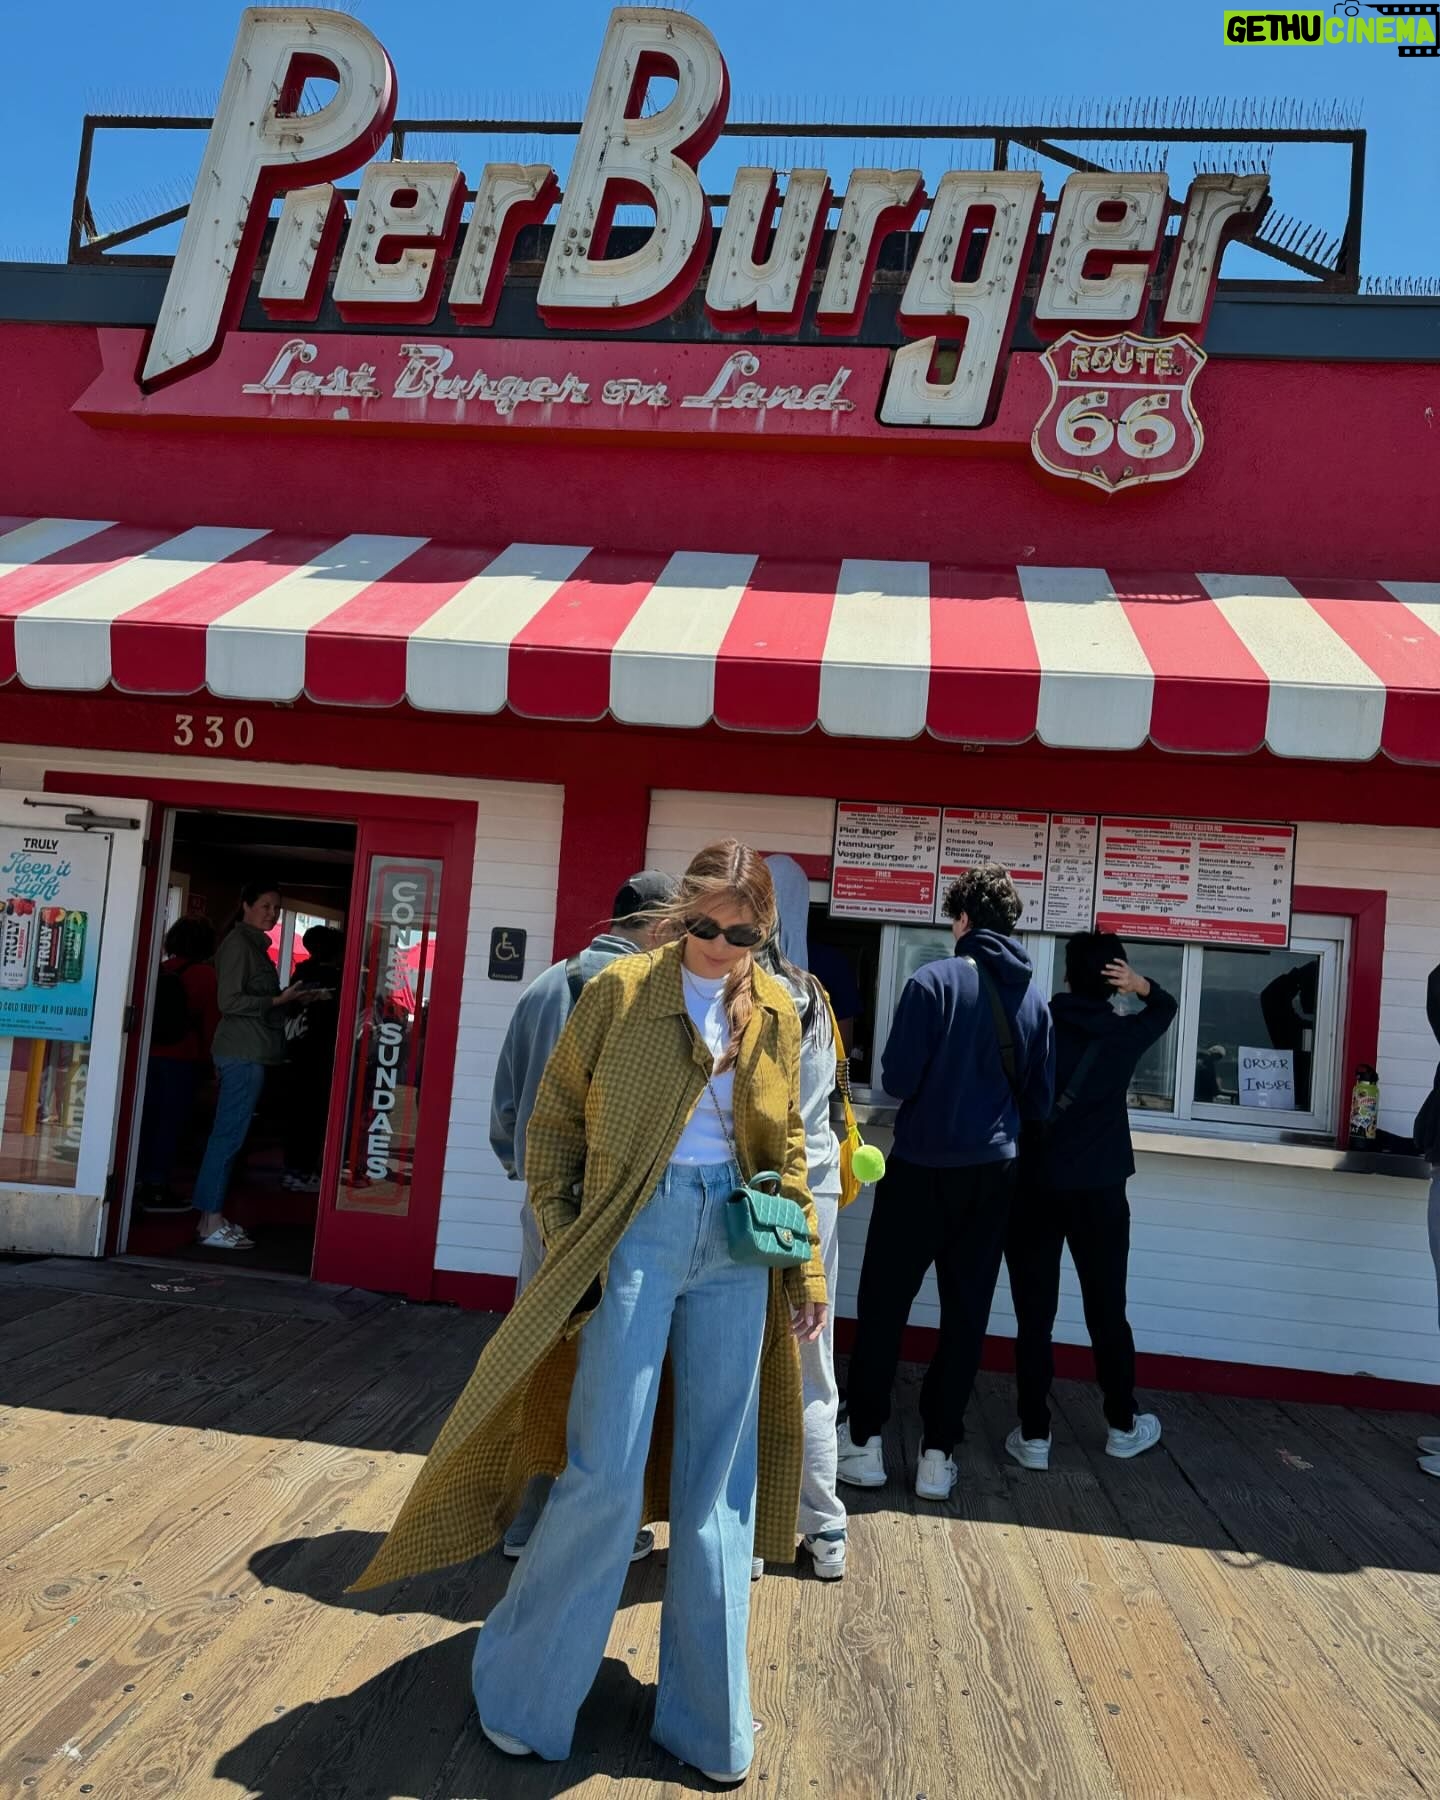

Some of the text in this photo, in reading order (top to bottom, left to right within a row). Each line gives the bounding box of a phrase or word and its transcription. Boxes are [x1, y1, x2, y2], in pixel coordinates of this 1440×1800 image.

[1070, 345, 1177, 377] ROUTE
[242, 339, 855, 414] Last Burger on Land
[1056, 391, 1176, 459] 66
[173, 713, 254, 748] 330
[24, 837, 59, 850] TRULY
[839, 826, 860, 834] Pier
[862, 827, 898, 837] Burger
[961, 828, 978, 836] Dog
[977, 839, 994, 847] Dog
[837, 848, 871, 859] Veggie
[873, 851, 910, 861] Burger
[838, 840, 895, 850] Hamburger
[975, 852, 991, 860] Dog
[2, 851, 72, 880] Keep it
[1230, 858, 1252, 866] Berry
[7, 875, 61, 901] Light
[3, 919, 20, 967] TRULY
[37, 925, 53, 968] TRULY
[384, 881, 418, 991] CONES
[1243, 1057, 1289, 1070] ORDER
[365, 1022, 403, 1180] SUNDAES
